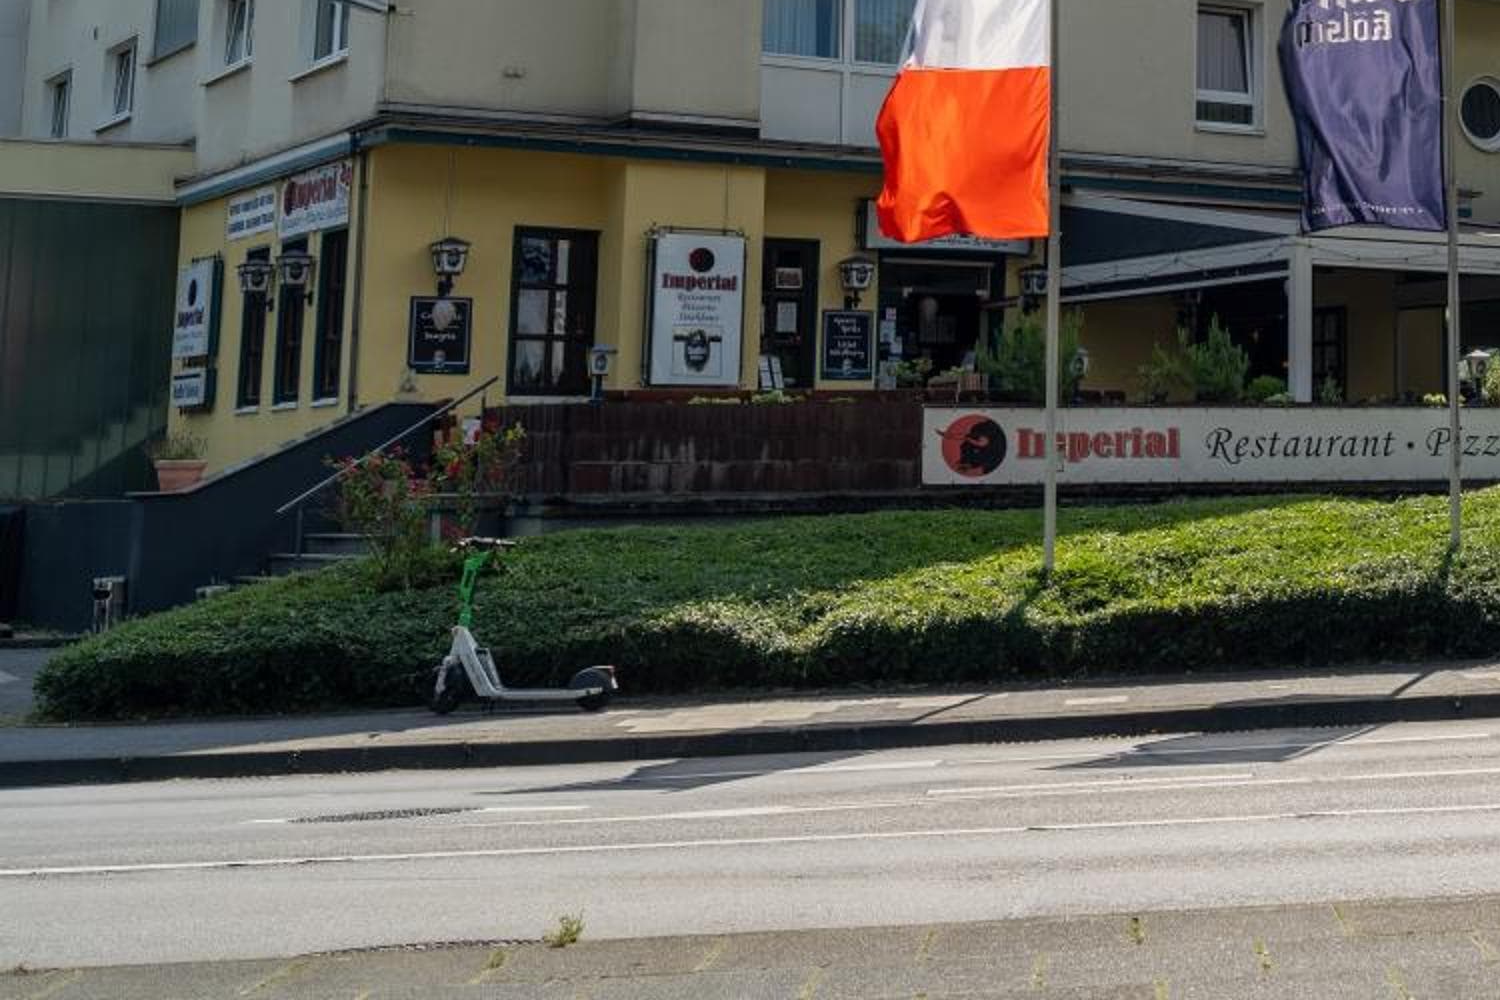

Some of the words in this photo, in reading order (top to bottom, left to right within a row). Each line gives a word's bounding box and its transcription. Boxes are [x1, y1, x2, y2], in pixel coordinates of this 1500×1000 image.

[661, 272, 737, 292] Imperial
[1016, 427, 1182, 463] Imperial
[1206, 427, 1397, 465] Restaurant
